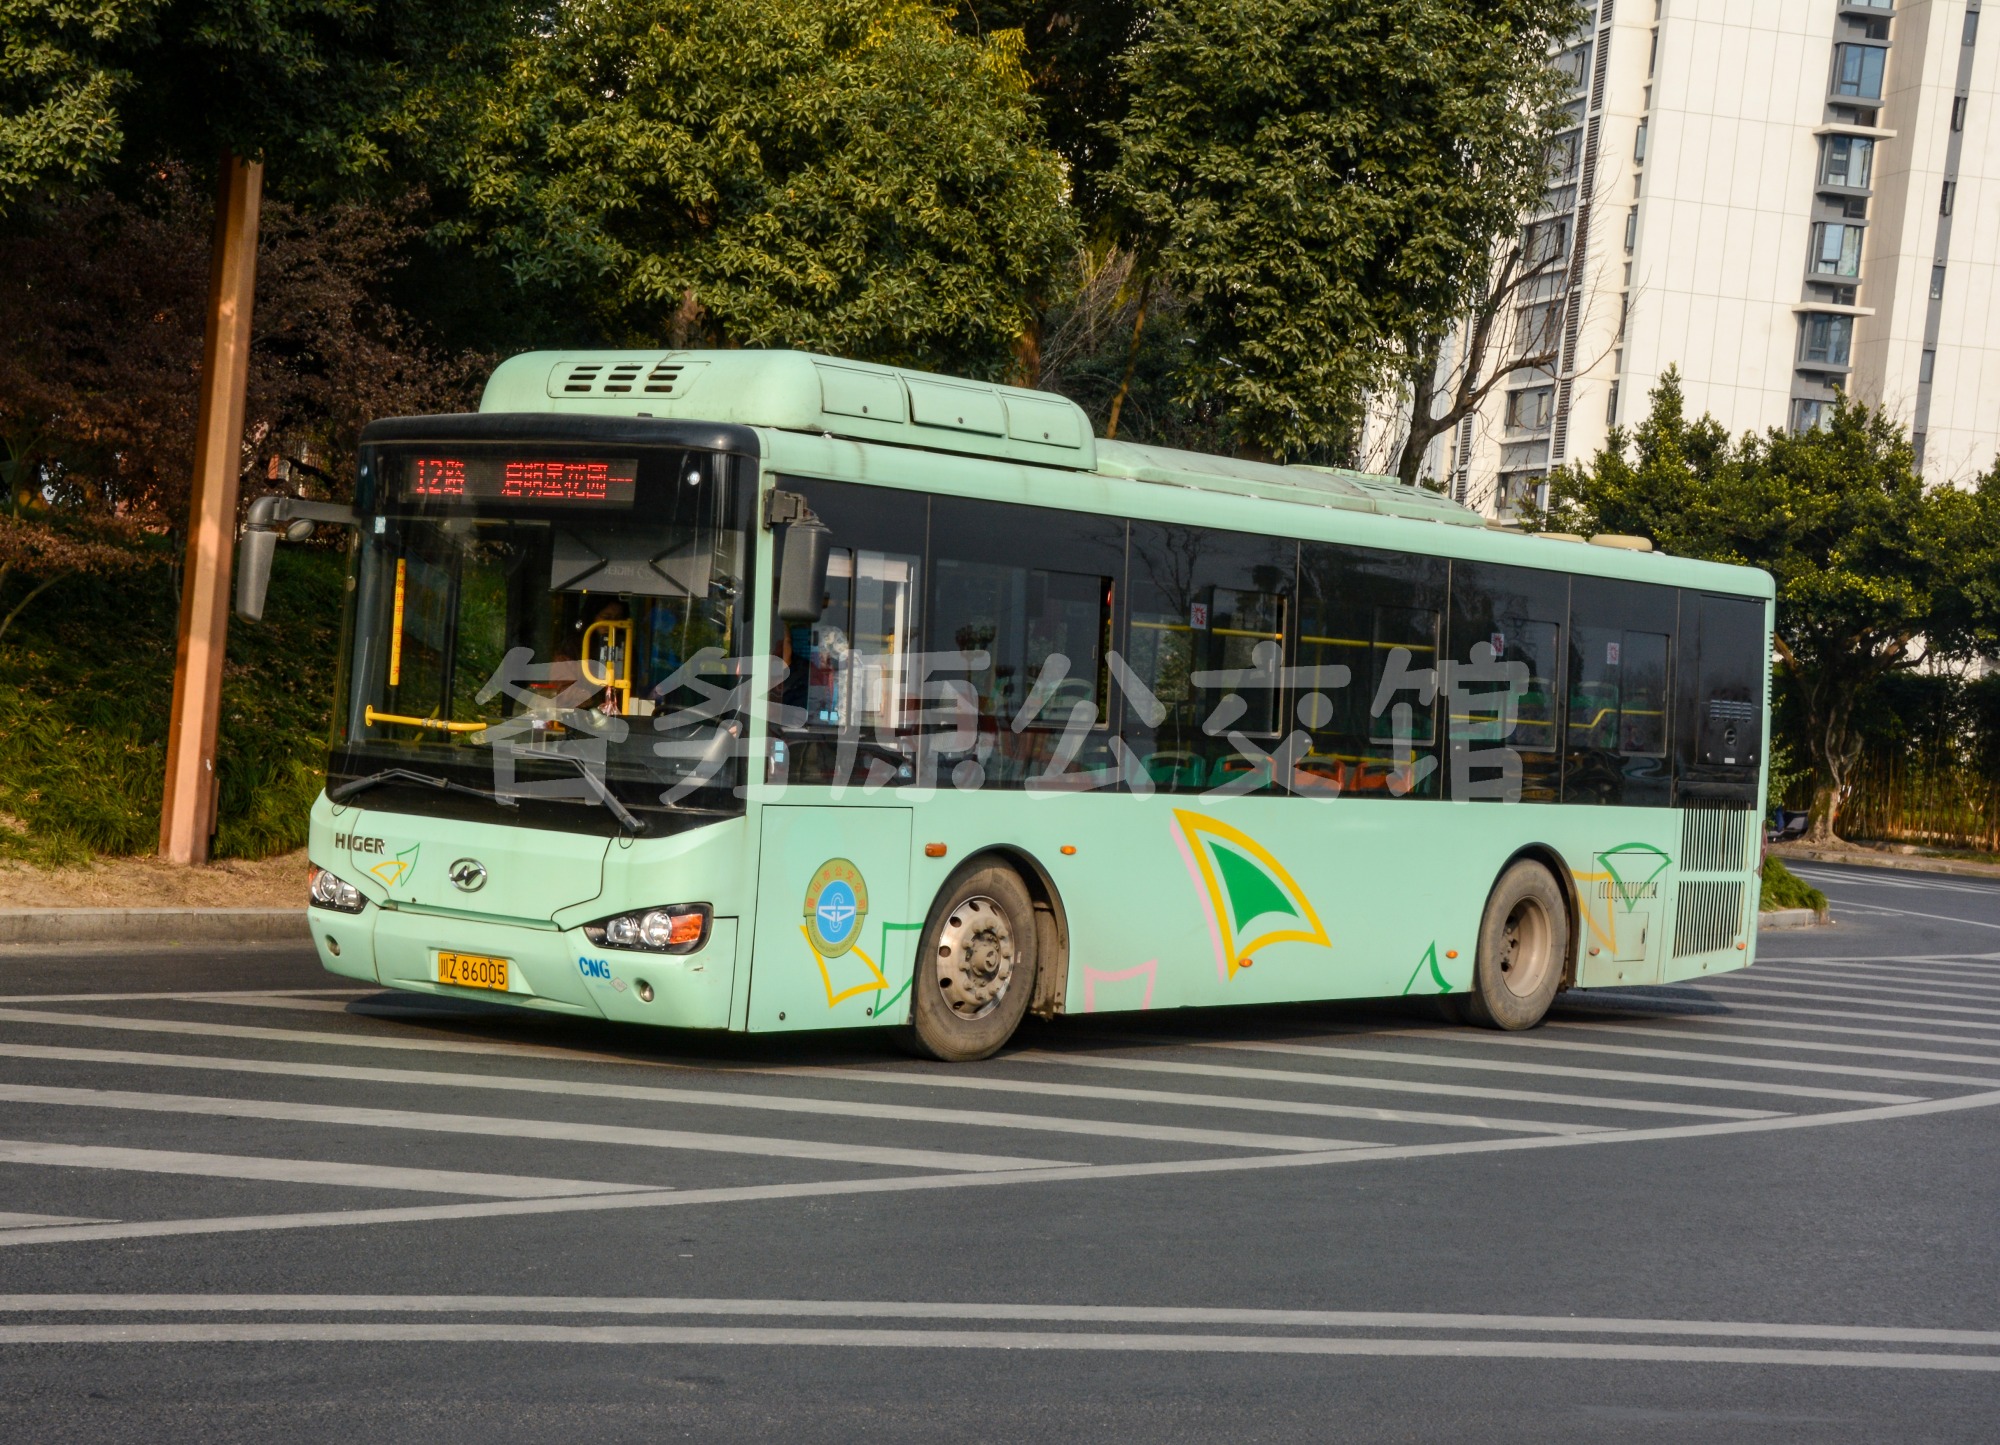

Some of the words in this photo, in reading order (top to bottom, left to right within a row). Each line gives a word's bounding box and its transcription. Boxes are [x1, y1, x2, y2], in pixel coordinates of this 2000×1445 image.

[416, 459, 465, 495] 12路
[335, 832, 385, 855] HIGER
[578, 956, 611, 979] CNG
